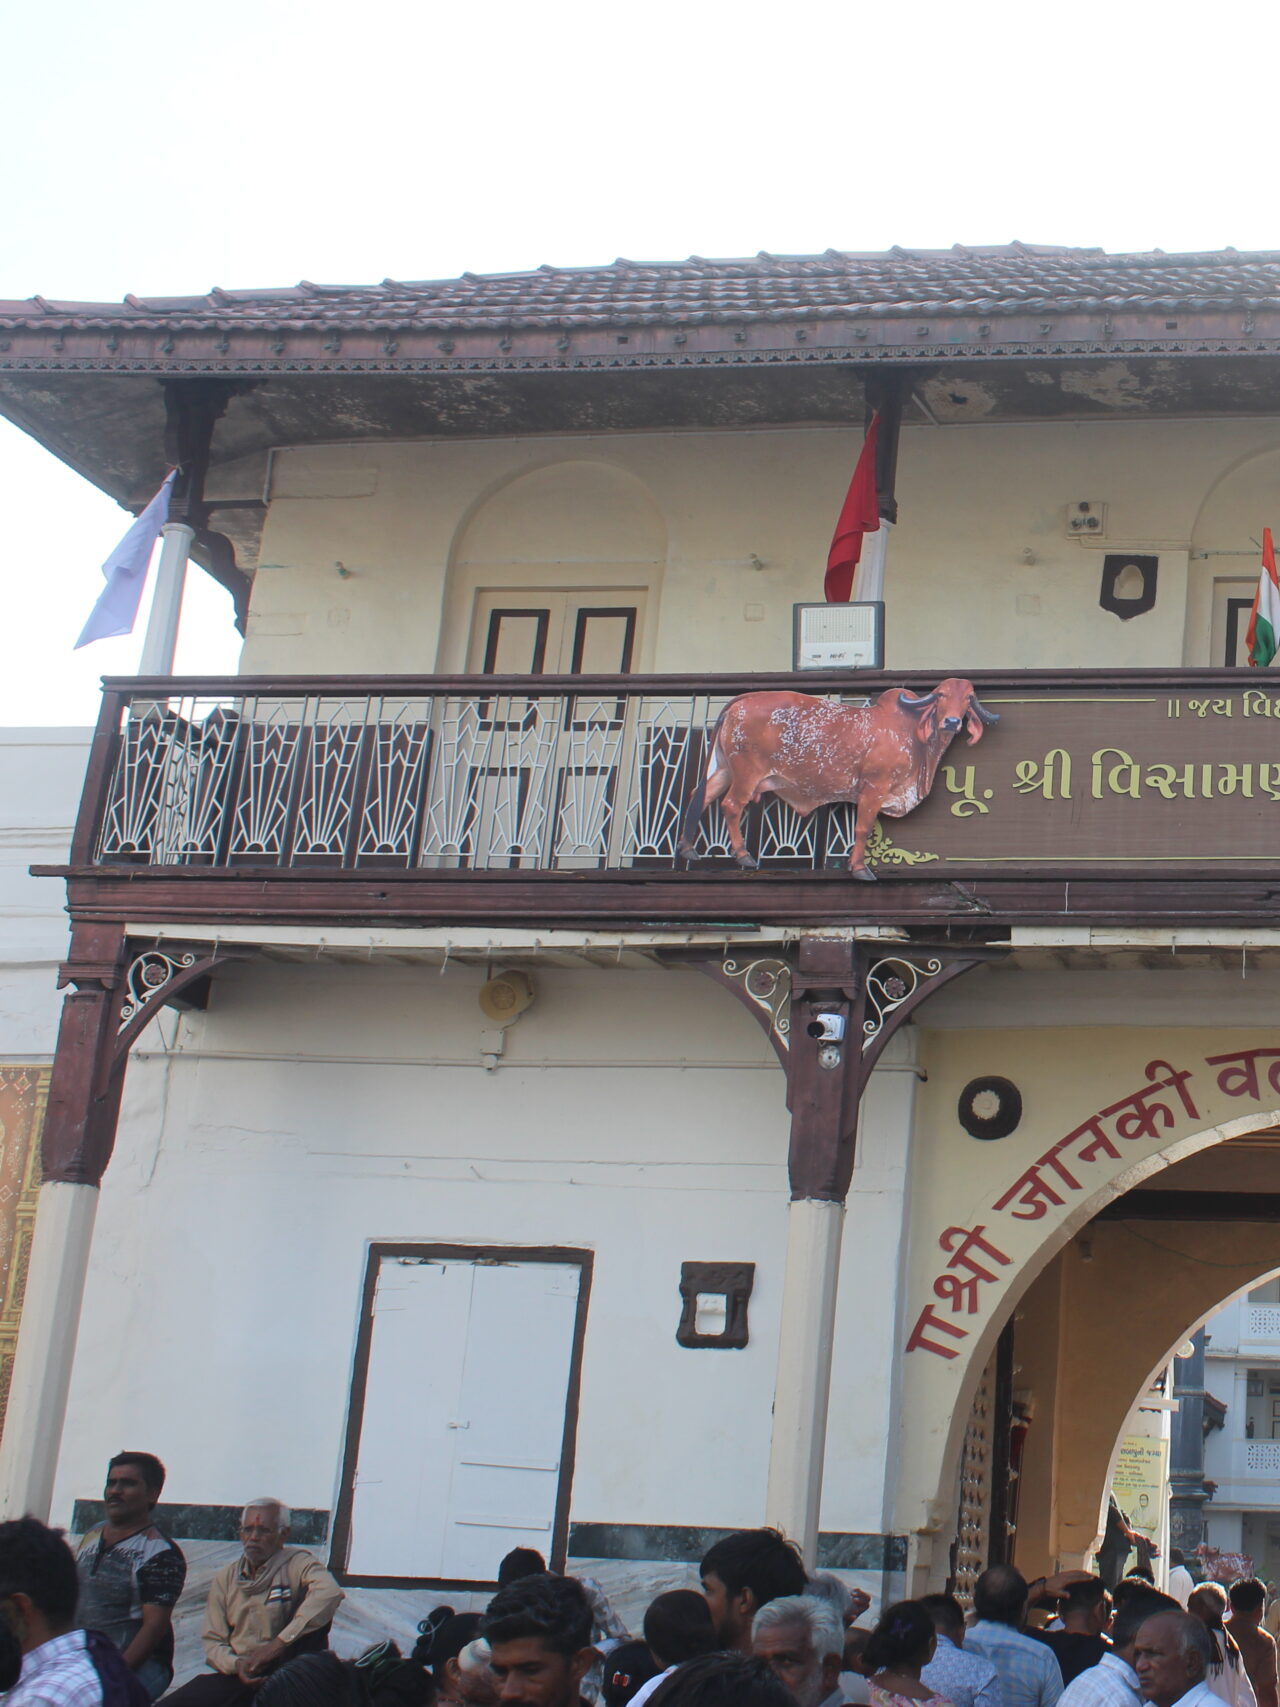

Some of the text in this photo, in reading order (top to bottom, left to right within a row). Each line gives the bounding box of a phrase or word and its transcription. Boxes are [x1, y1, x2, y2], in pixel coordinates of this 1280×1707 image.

[1188, 699, 1233, 718] જય
[941, 765, 994, 818] પૂ.
[1012, 748, 1073, 800] શ્રી
[933, 1225, 1014, 1315] श्री
[991, 1059, 1201, 1221] जानकी
